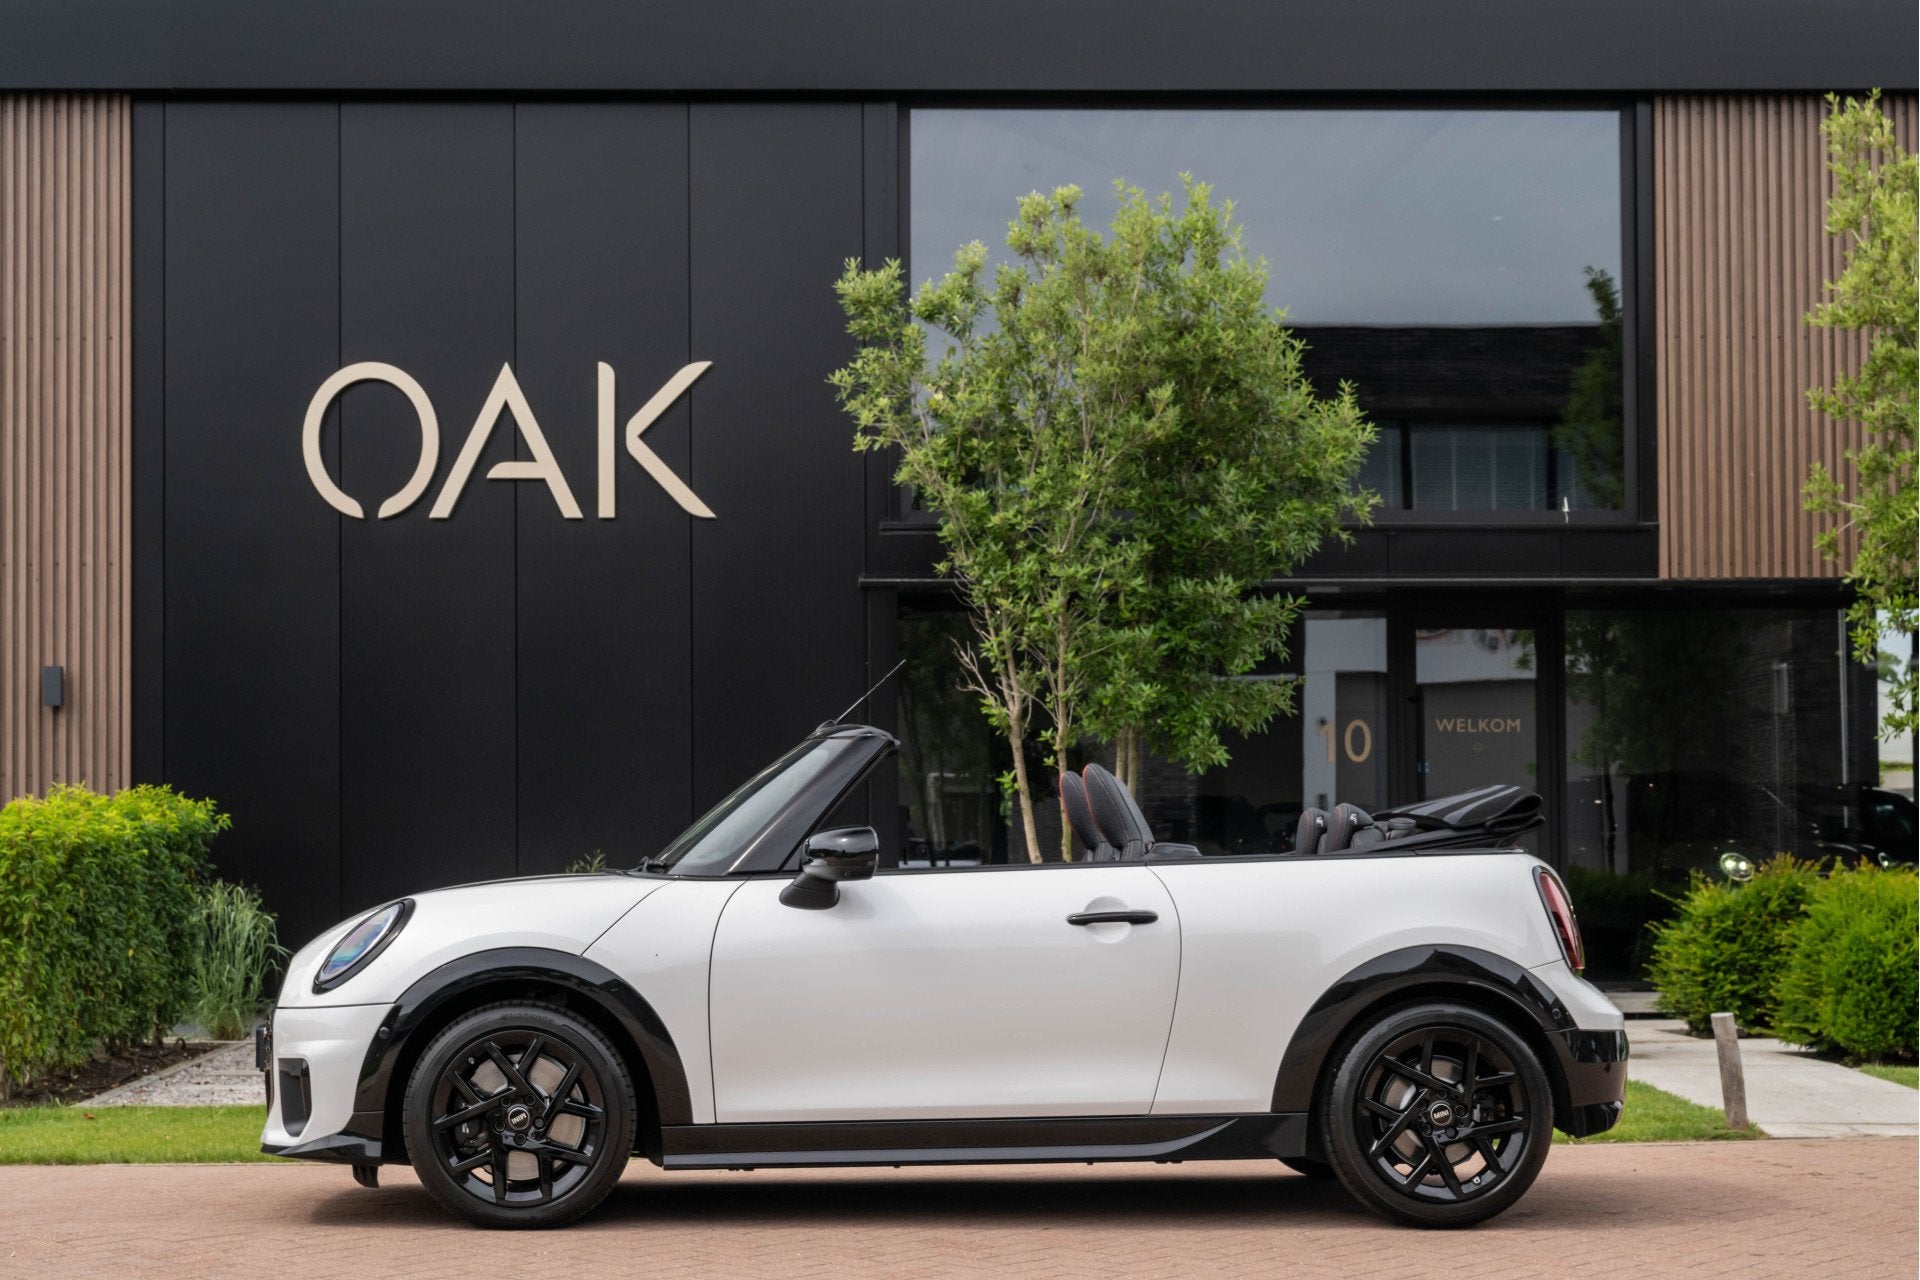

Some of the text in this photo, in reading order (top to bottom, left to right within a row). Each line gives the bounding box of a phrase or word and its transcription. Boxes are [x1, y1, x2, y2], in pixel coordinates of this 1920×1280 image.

[303, 361, 717, 519] OAK
[1435, 718, 1521, 733] WELKOM
[1317, 719, 1372, 763] 10
[1433, 1109, 1450, 1120] MINI
